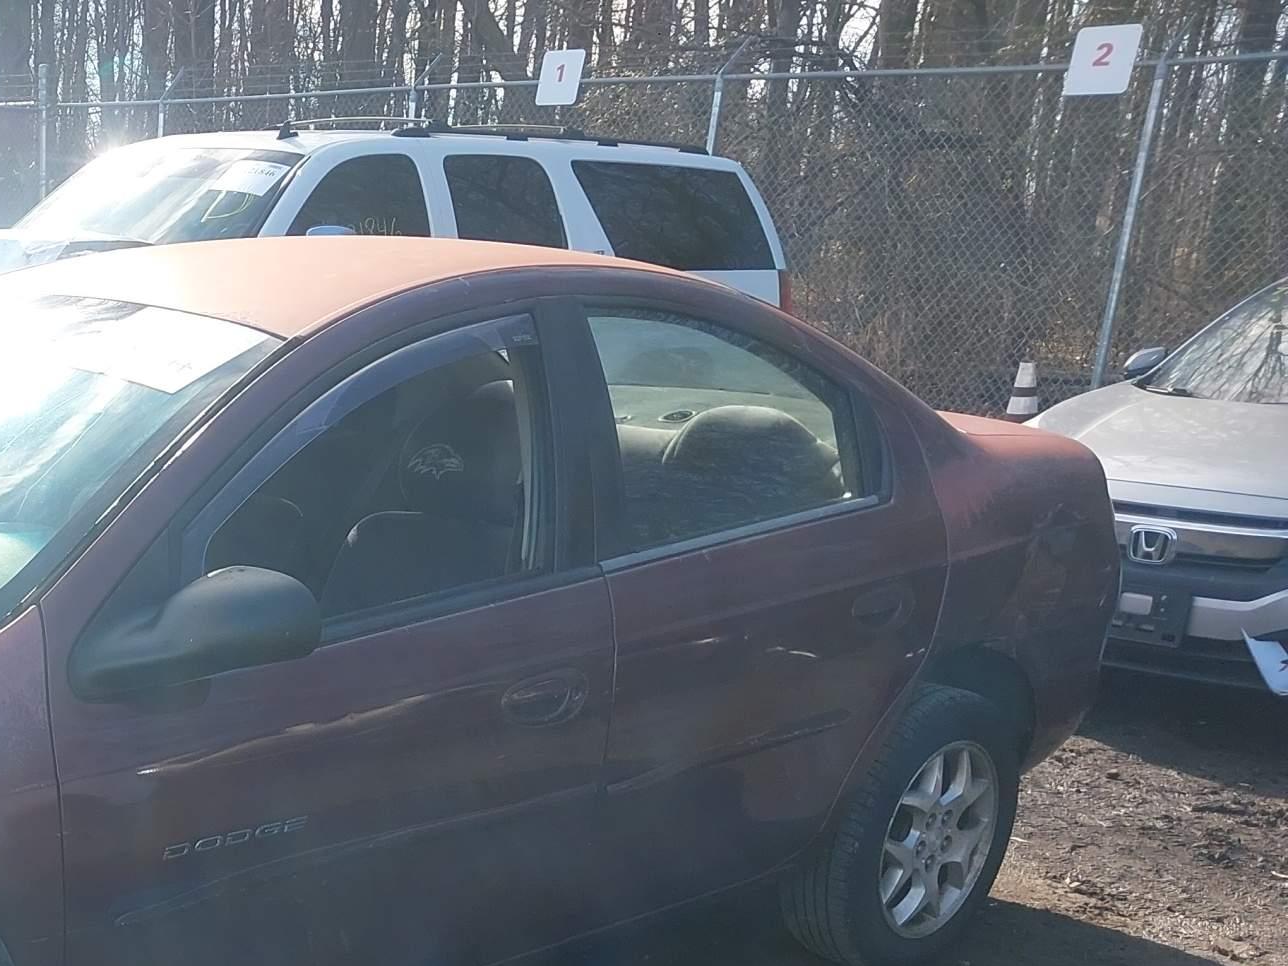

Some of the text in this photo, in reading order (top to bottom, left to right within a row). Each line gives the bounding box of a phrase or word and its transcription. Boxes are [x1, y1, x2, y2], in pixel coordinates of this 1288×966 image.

[1092, 42, 1114, 67] 2
[556, 63, 566, 83] 1
[163, 815, 309, 861] DODGE
